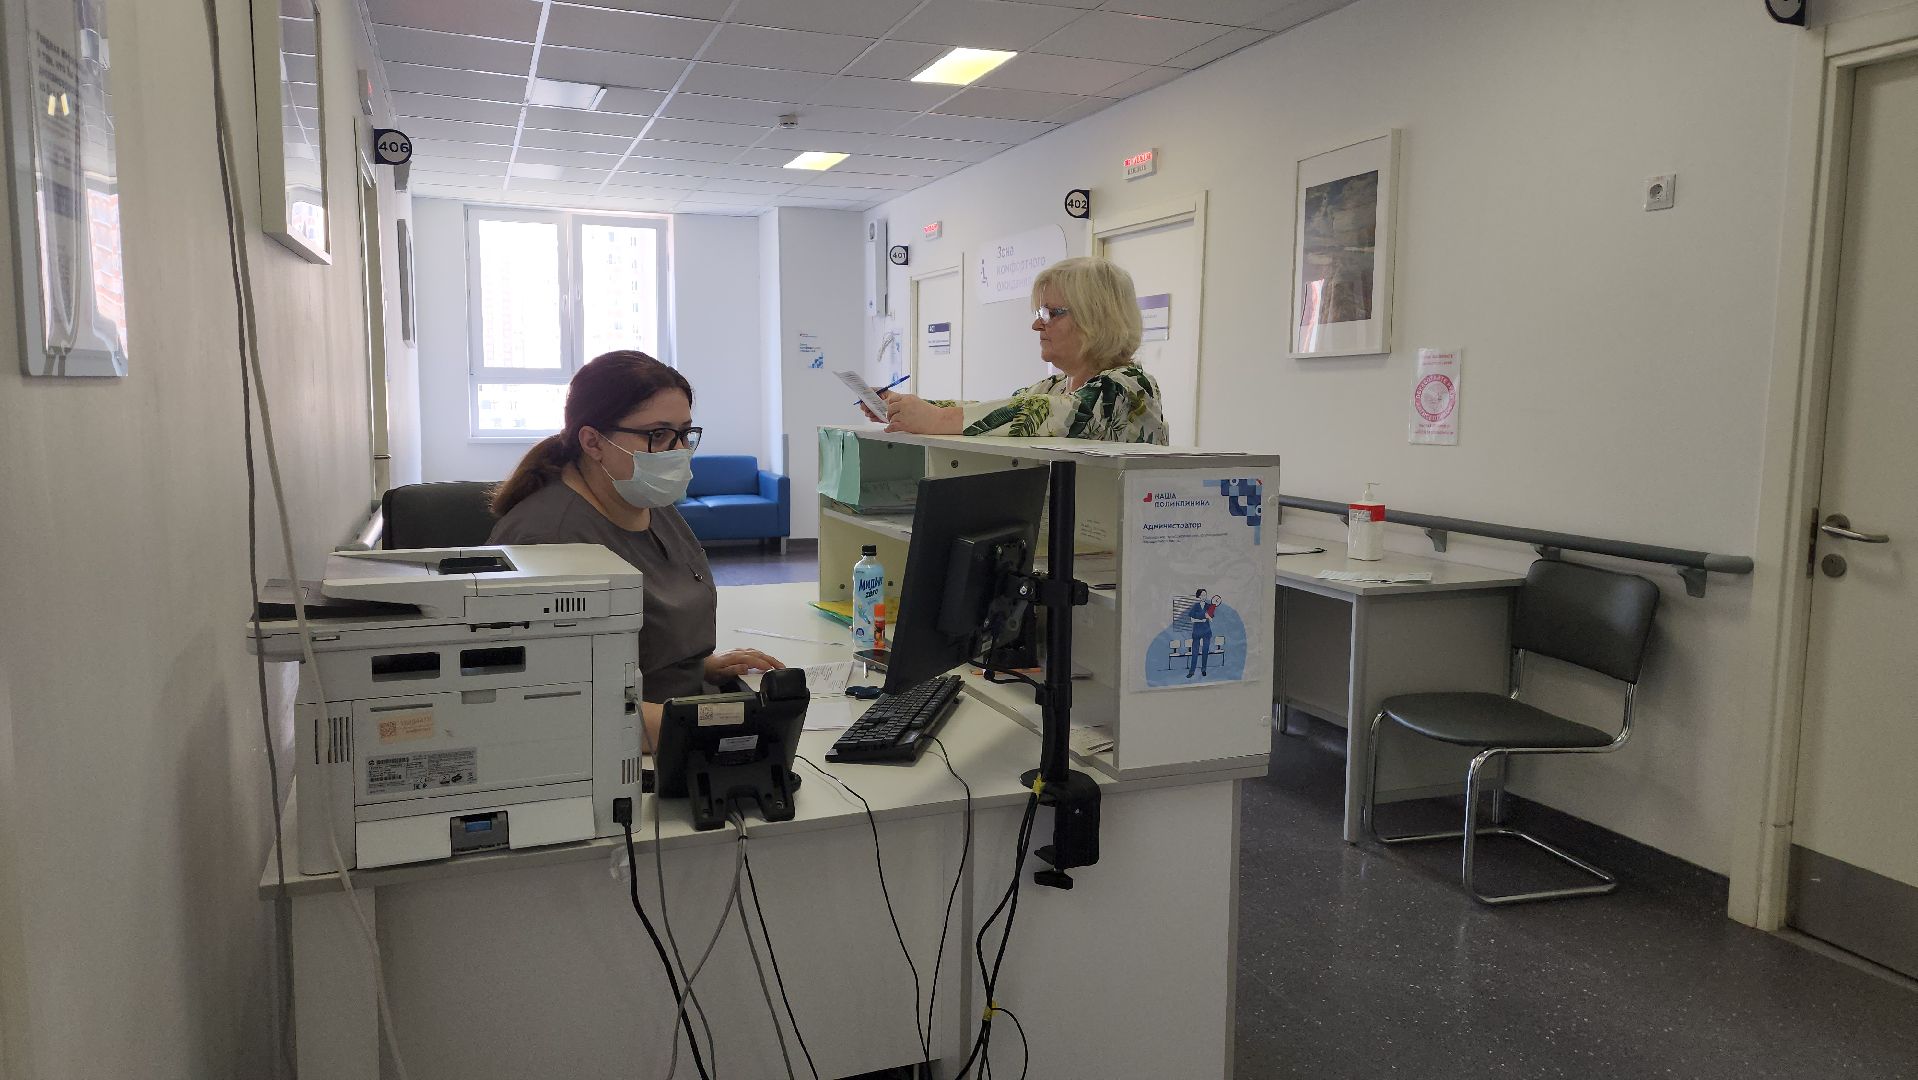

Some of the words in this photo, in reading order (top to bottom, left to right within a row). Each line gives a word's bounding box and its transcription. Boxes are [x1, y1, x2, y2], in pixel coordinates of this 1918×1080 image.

[378, 141, 409, 153] 406
[1067, 199, 1087, 209] 402
[1154, 492, 1177, 500] НАША
[1154, 499, 1210, 508] ПОЛИКЛИНИКА
[1142, 522, 1202, 531] Администратор
